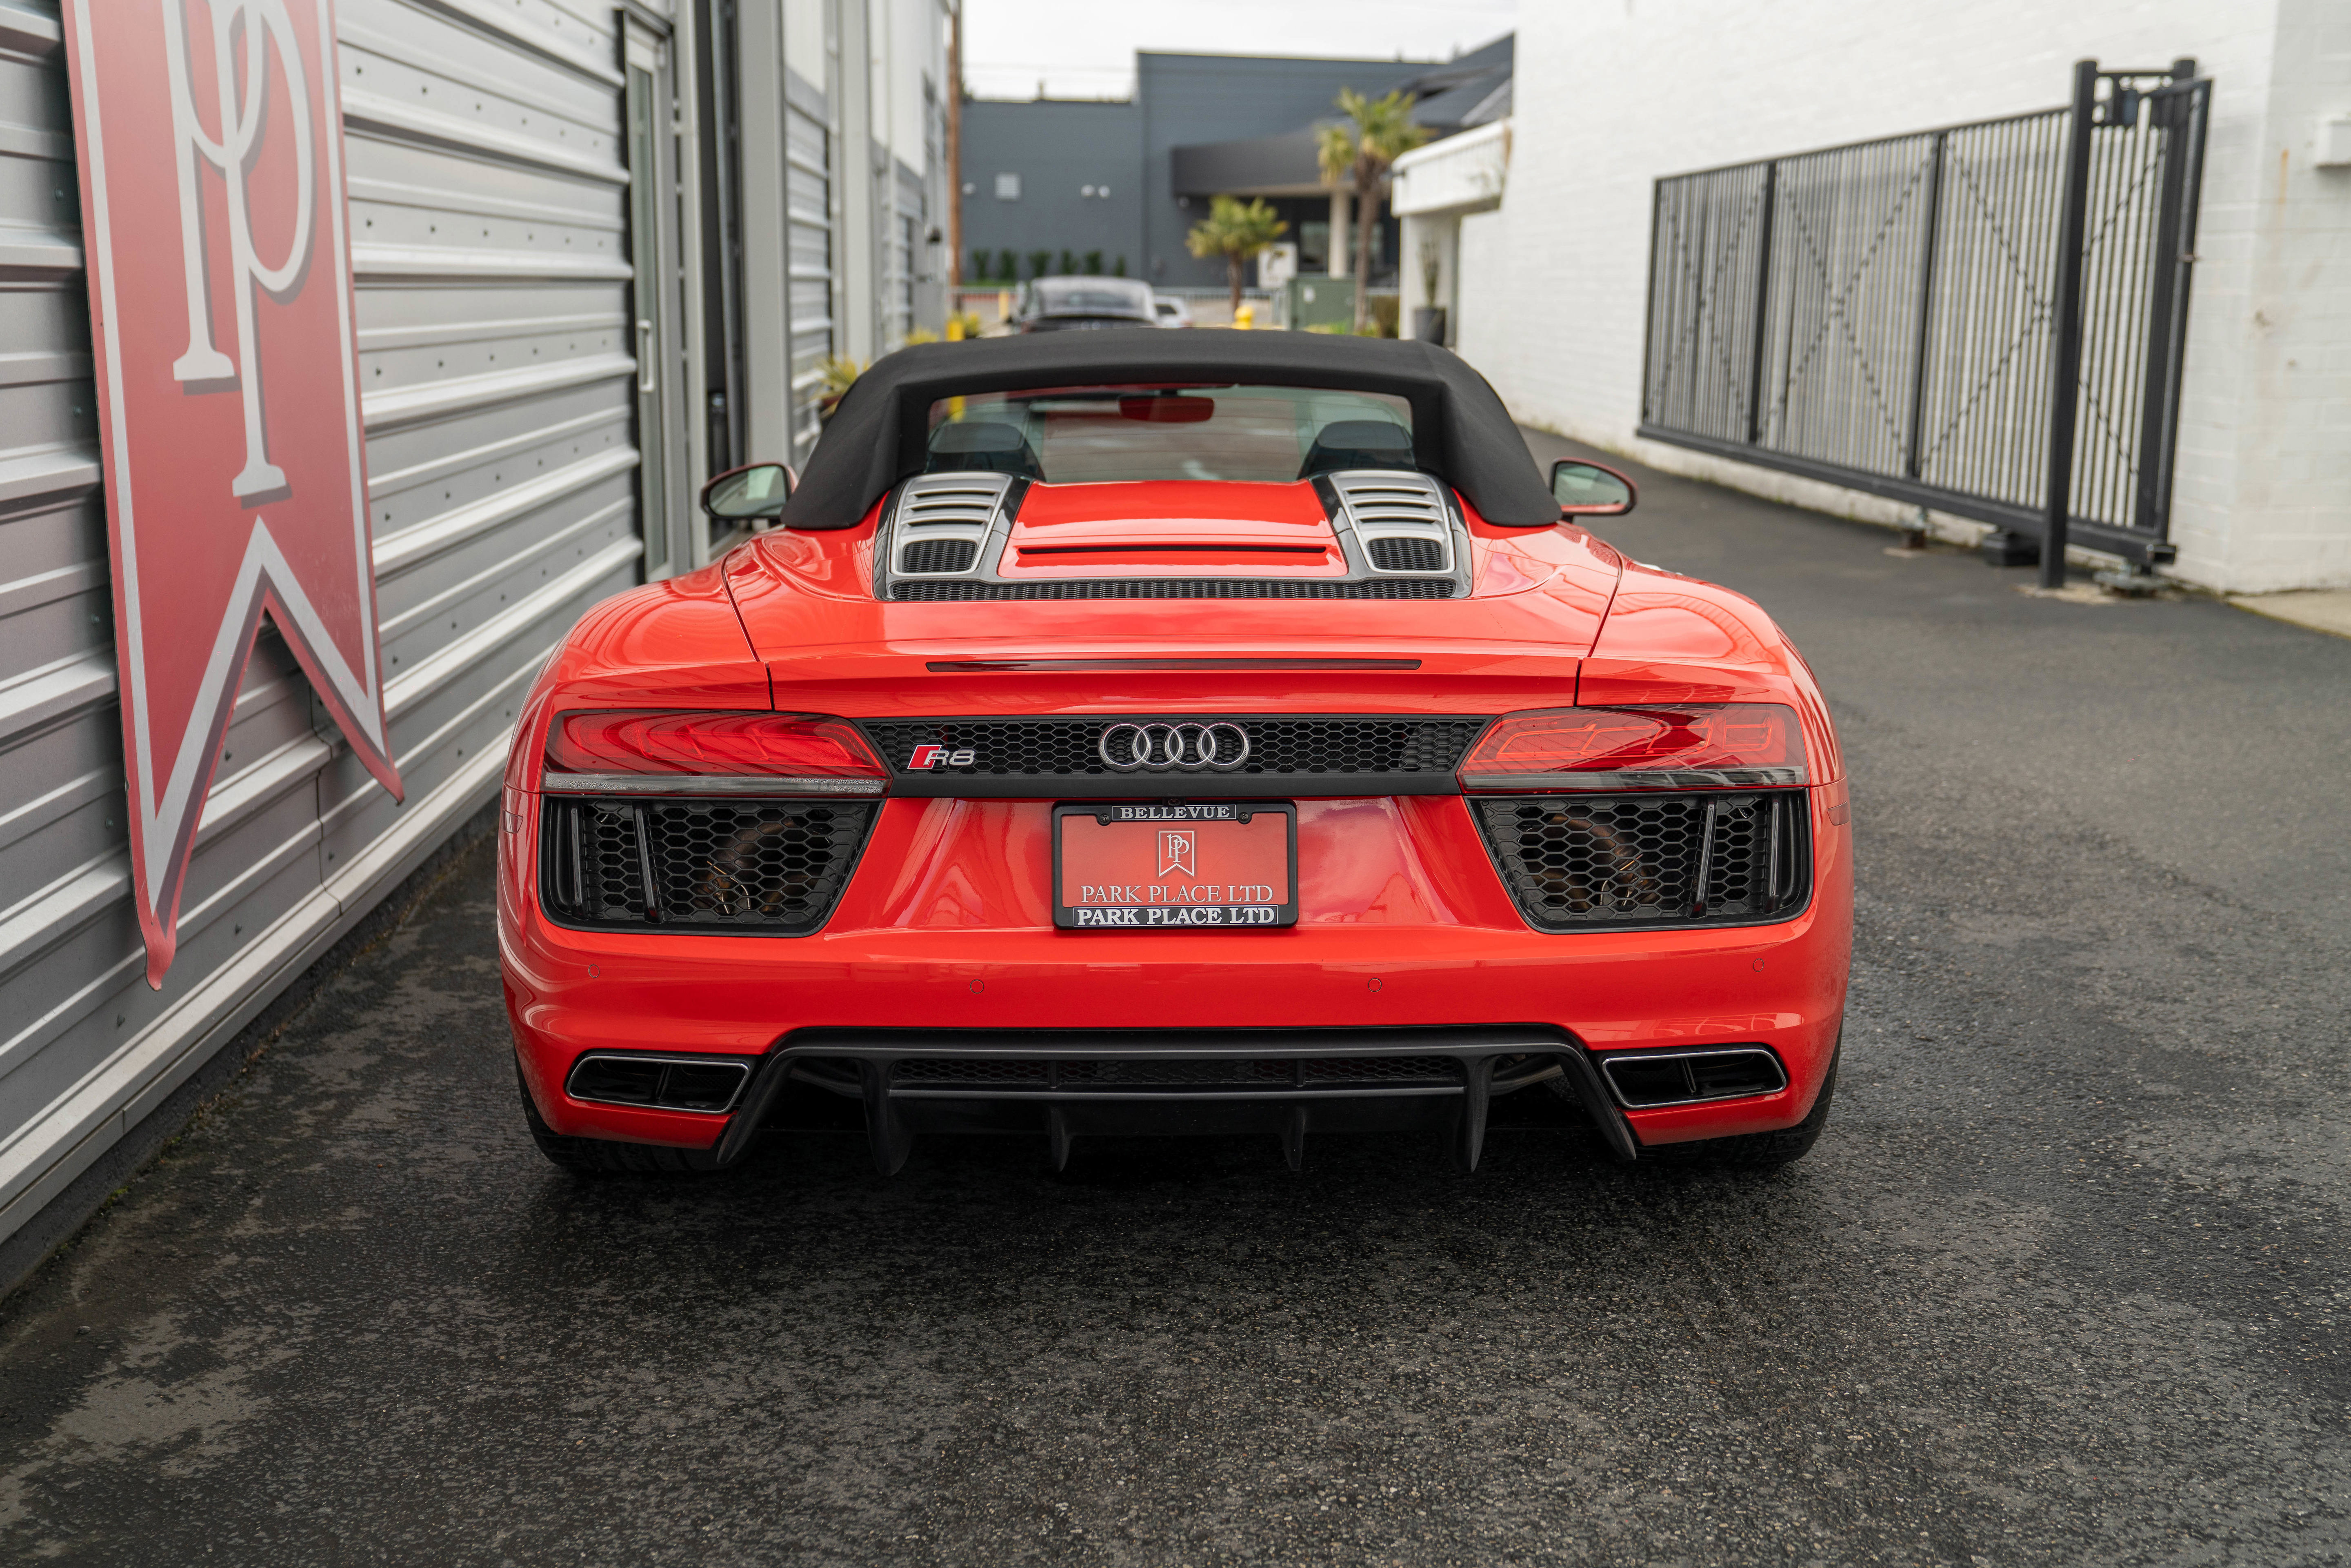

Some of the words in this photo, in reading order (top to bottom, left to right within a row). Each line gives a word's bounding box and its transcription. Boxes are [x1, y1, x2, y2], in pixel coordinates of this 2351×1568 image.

[923, 750, 975, 766] R8
[1120, 806, 1229, 819] BELLEVUE
[1081, 886, 1142, 902] PARK
[1148, 885, 1221, 902] PLACE
[1227, 885, 1273, 902] LTD
[1077, 908, 1140, 925] PARK
[1147, 908, 1222, 924] PLACE
[1229, 907, 1275, 924] LTD
